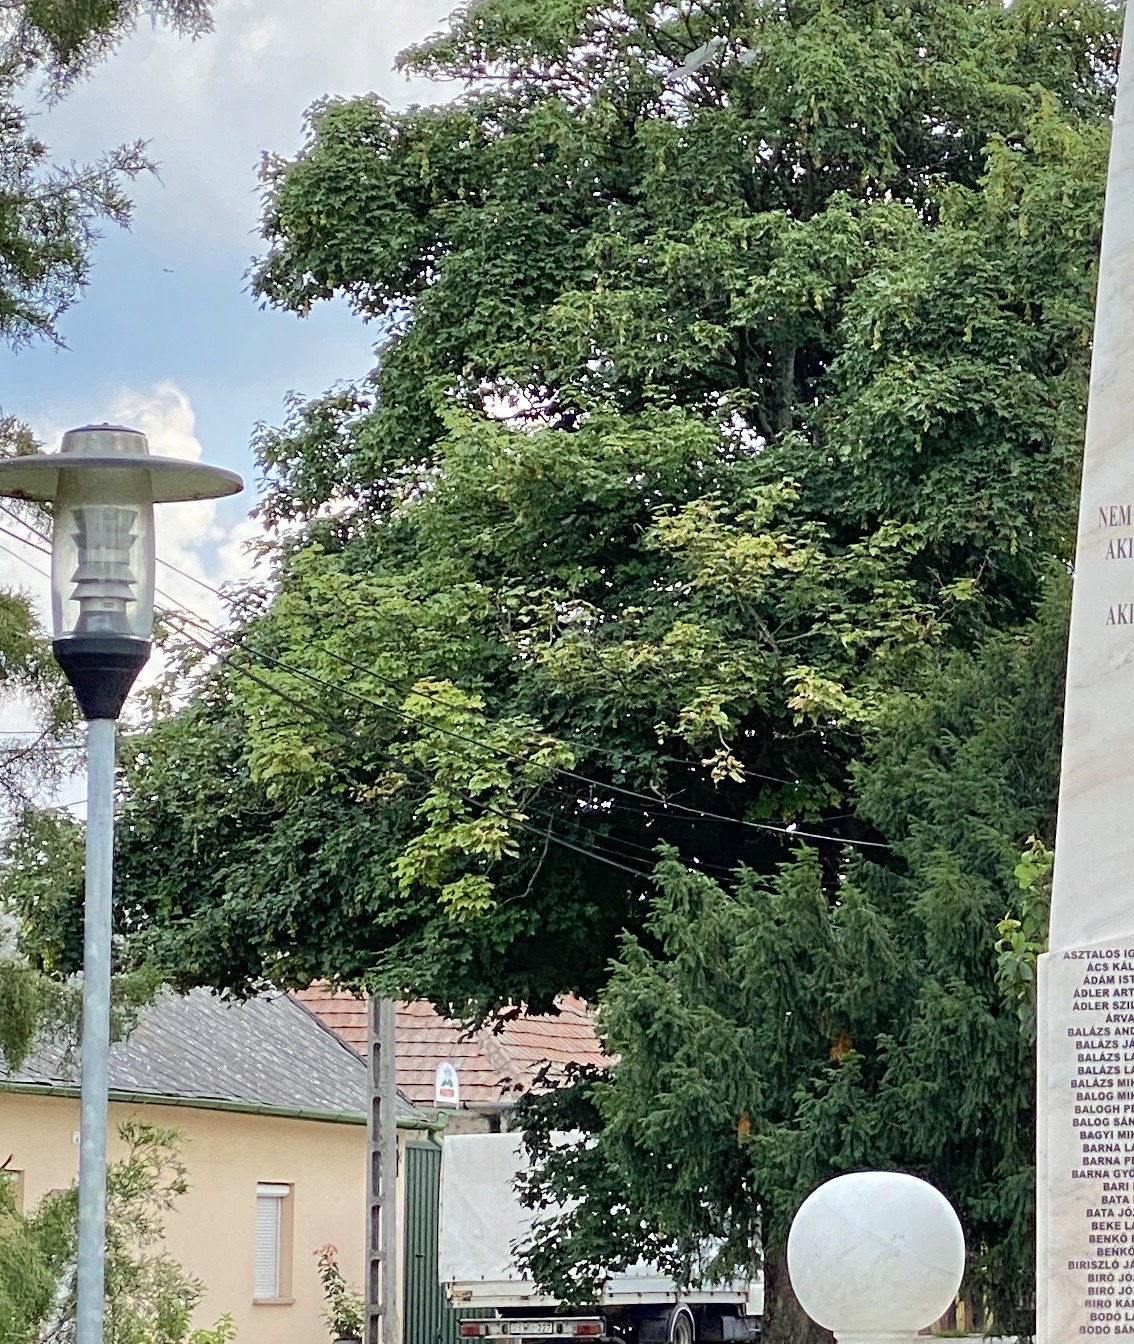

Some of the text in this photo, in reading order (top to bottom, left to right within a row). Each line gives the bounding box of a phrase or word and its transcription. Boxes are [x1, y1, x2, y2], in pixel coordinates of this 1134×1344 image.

[1098, 505, 1132, 528] NEM
[1063, 950, 1121, 960] ASZTALOS
[1067, 1026, 1111, 1037] BALÁZS
[1075, 1039, 1119, 1050] BALÁZS
[1077, 1051, 1121, 1062] BALÁZS
[1077, 1064, 1121, 1075] BALÁZS
[1070, 1077, 1114, 1088] BALÁZS
[1076, 1092, 1114, 1101] BALOG
[1074, 1105, 1120, 1114] BALOGH
[1072, 1118, 1110, 1127] BALOG
[1080, 1131, 1114, 1140] BAGYI
[1082, 1143, 1121, 1153] BARNA
[1082, 1157, 1121, 1166] BARNA
[1071, 1169, 1110, 1179] BARNA
[1103, 1182, 1129, 1191] BARI
[1101, 1195, 1129, 1204] BATA
[1086, 1208, 1114, 1218] BATA
[1091, 1221, 1121, 1231] BEKE
